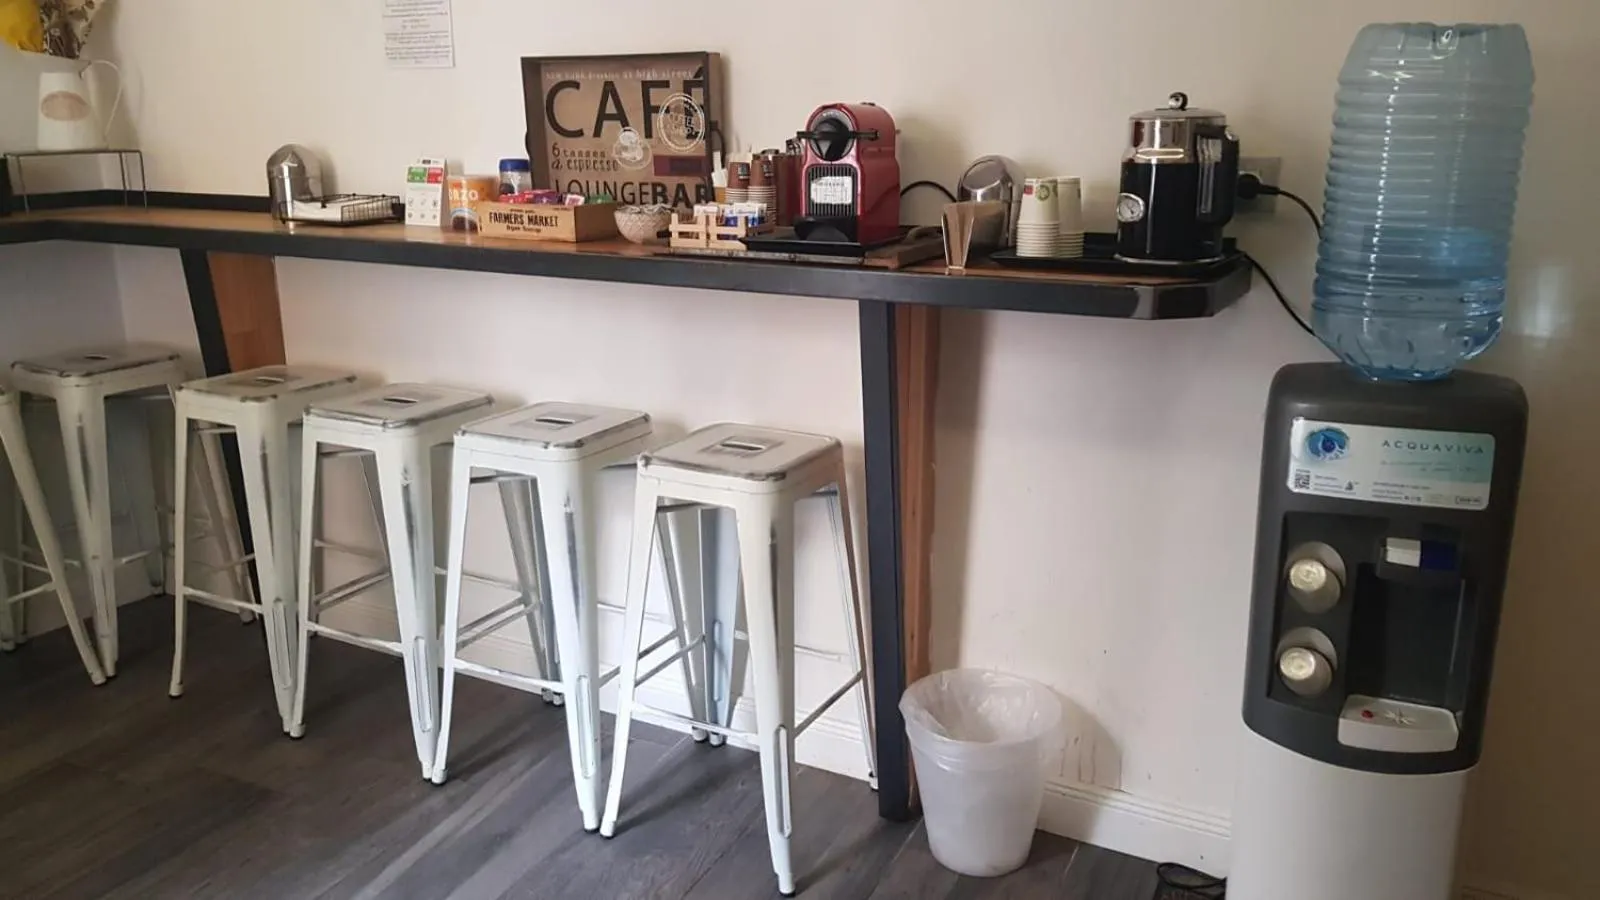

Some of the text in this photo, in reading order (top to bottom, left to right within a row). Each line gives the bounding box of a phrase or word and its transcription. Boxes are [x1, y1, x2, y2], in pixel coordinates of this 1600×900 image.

[545, 66, 706, 140] CAFÉ
[551, 142, 560, 158] 6
[489, 211, 559, 227] FARMERS MARKET
[1381, 440, 1484, 453] ACQUAVIVA
